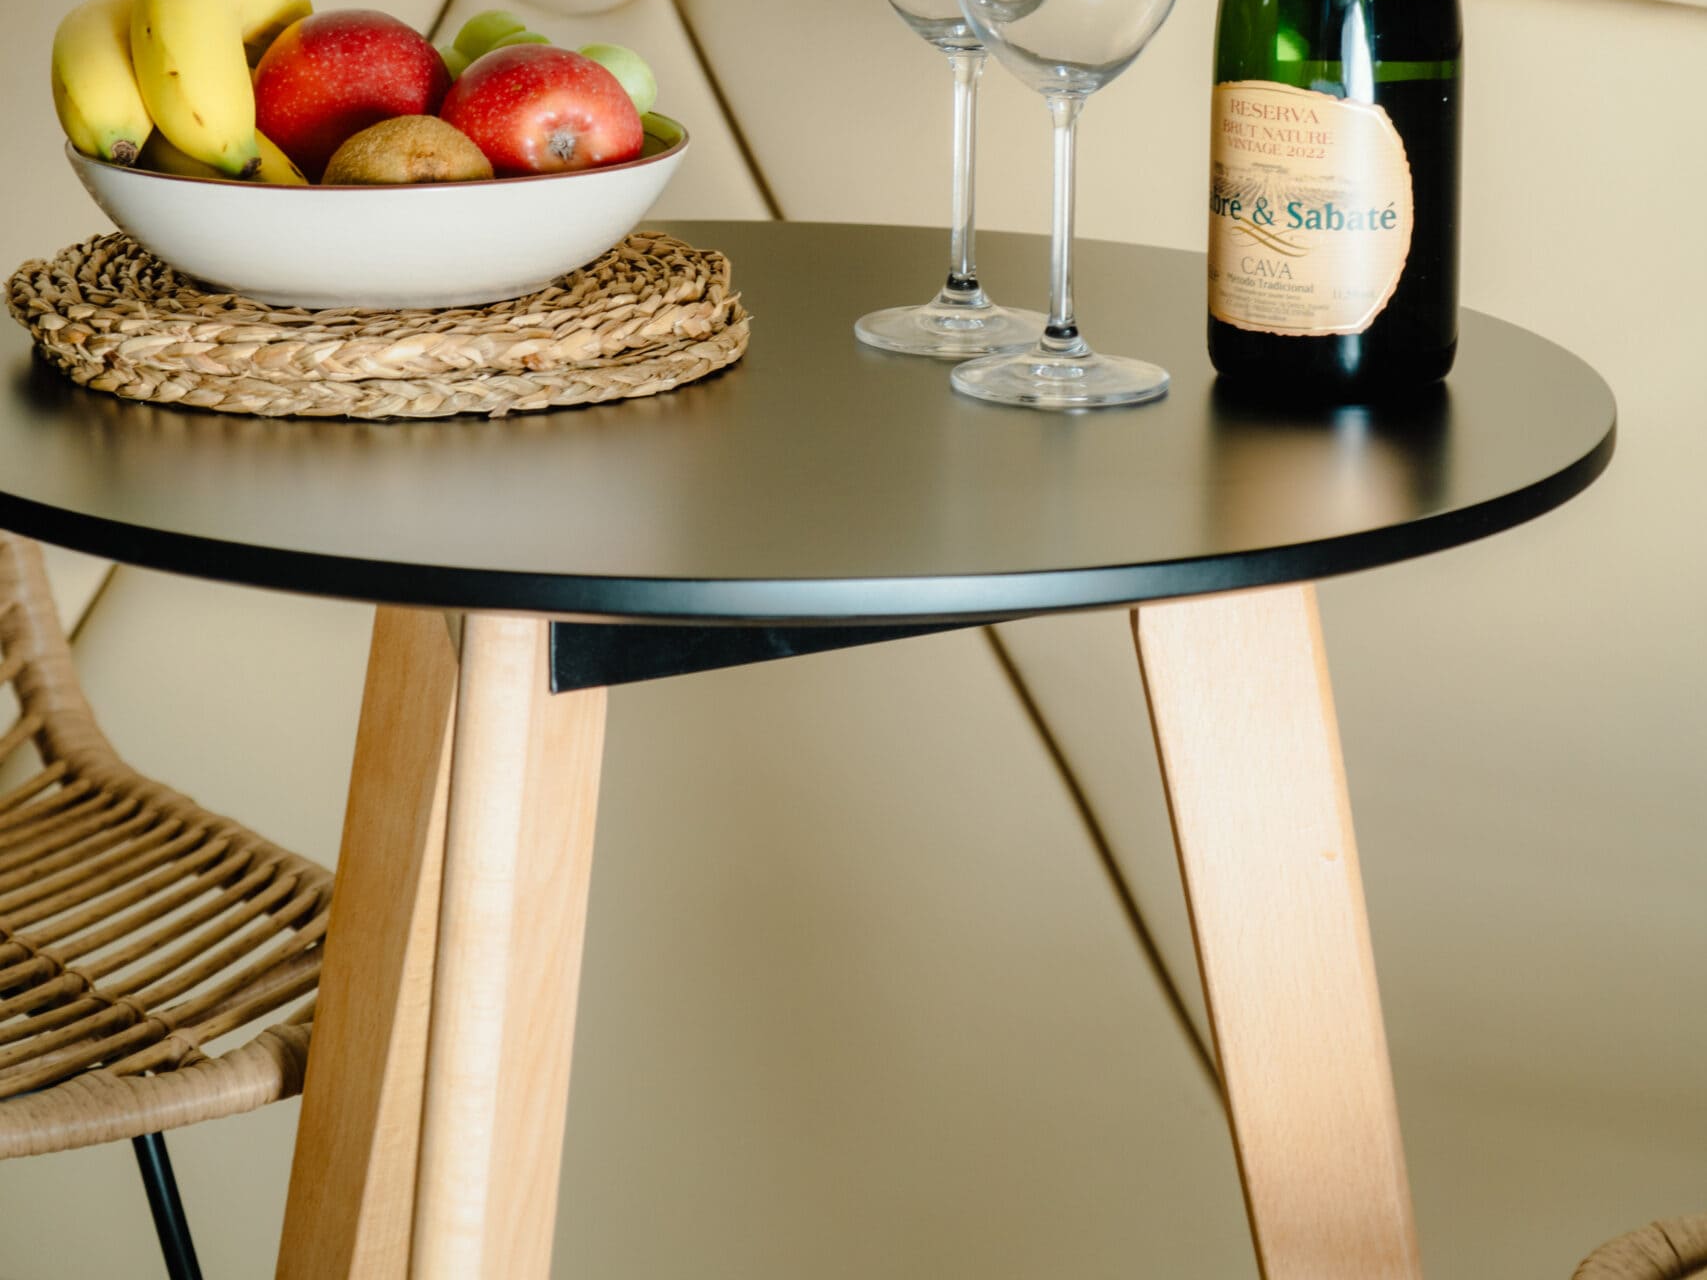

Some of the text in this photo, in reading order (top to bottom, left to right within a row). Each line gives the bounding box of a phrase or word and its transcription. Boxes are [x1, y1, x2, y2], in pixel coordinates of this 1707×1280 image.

[1230, 98, 1320, 124] RESERVA
[1222, 119, 1334, 145] BRUT NATURE
[1227, 137, 1326, 159] VINTAGE 2022
[1252, 196, 1276, 226] &
[1287, 202, 1397, 231] Sabaté
[1241, 256, 1293, 280] CAVA
